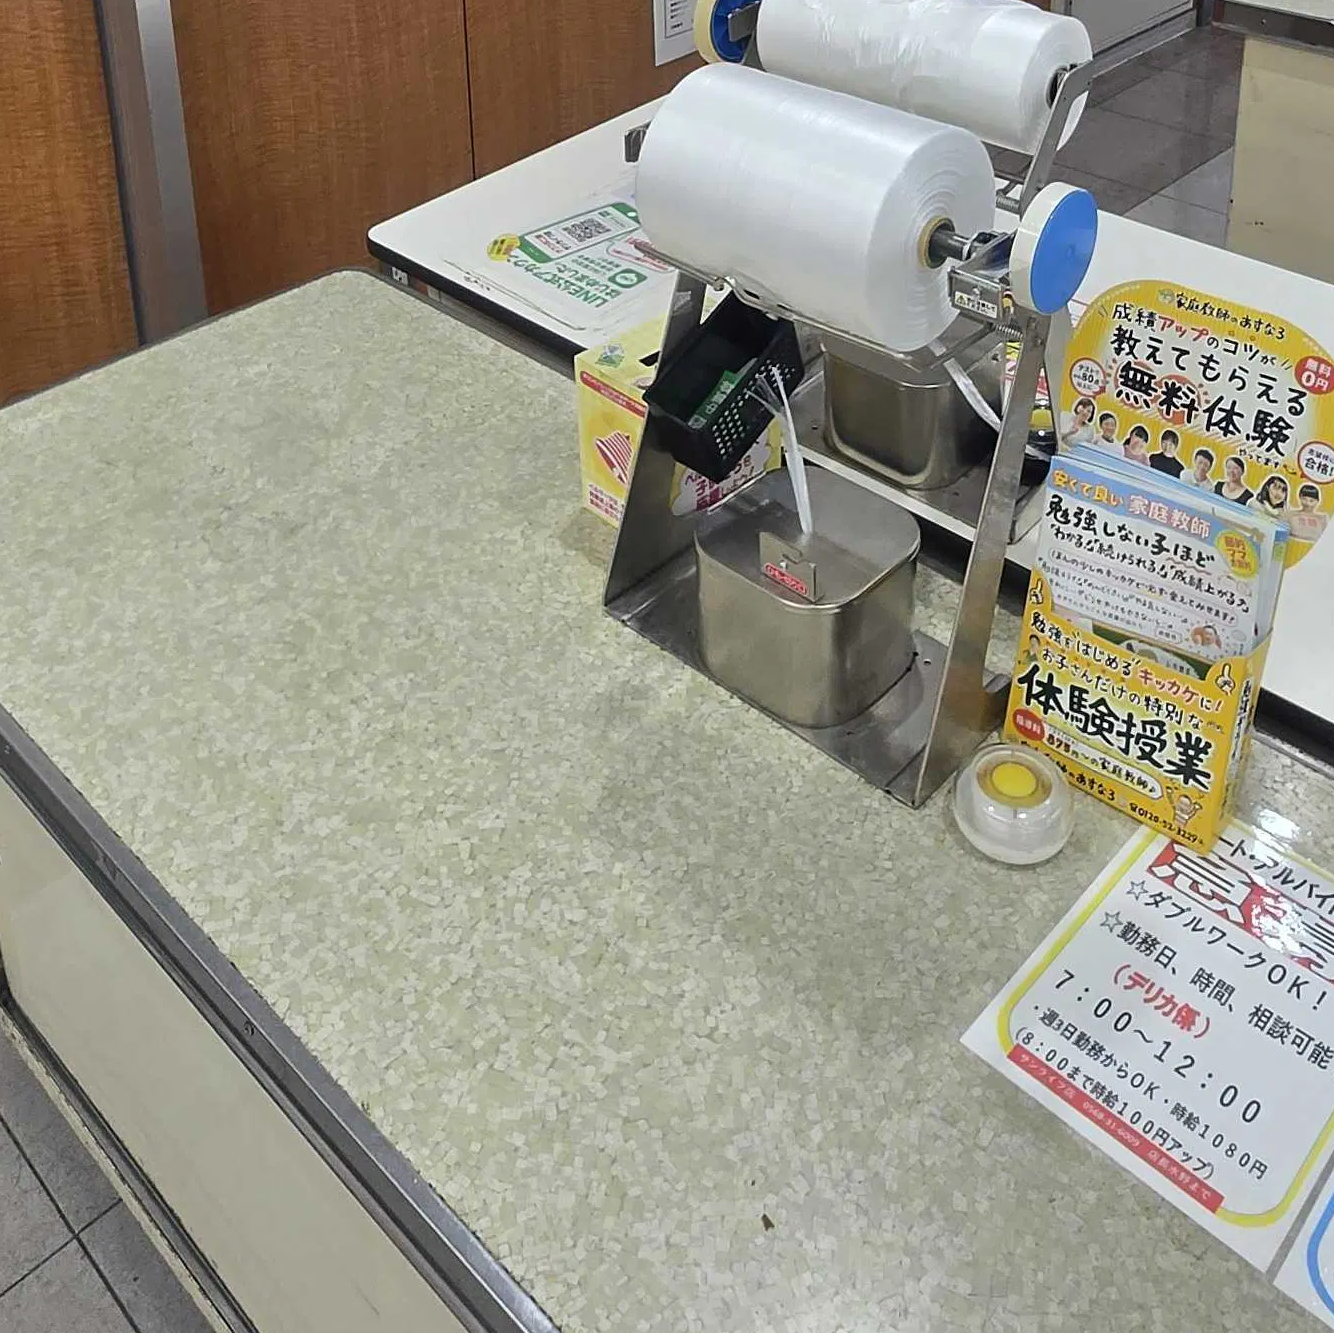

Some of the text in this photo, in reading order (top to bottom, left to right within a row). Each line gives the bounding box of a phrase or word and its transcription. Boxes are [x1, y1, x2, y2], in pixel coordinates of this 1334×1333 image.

[1110, 324, 1309, 418] 教えてもらえる
[1111, 302, 1278, 368] 成績アップのコツが
[1115, 359, 1295, 458] 無料体験
[1045, 493, 1216, 569] 勉強しない子ほど
[1128, 493, 1212, 540] 家庭教師
[1017, 663, 1213, 792] 体験授業
[1041, 647, 1204, 731] お子さんだけの特別な
